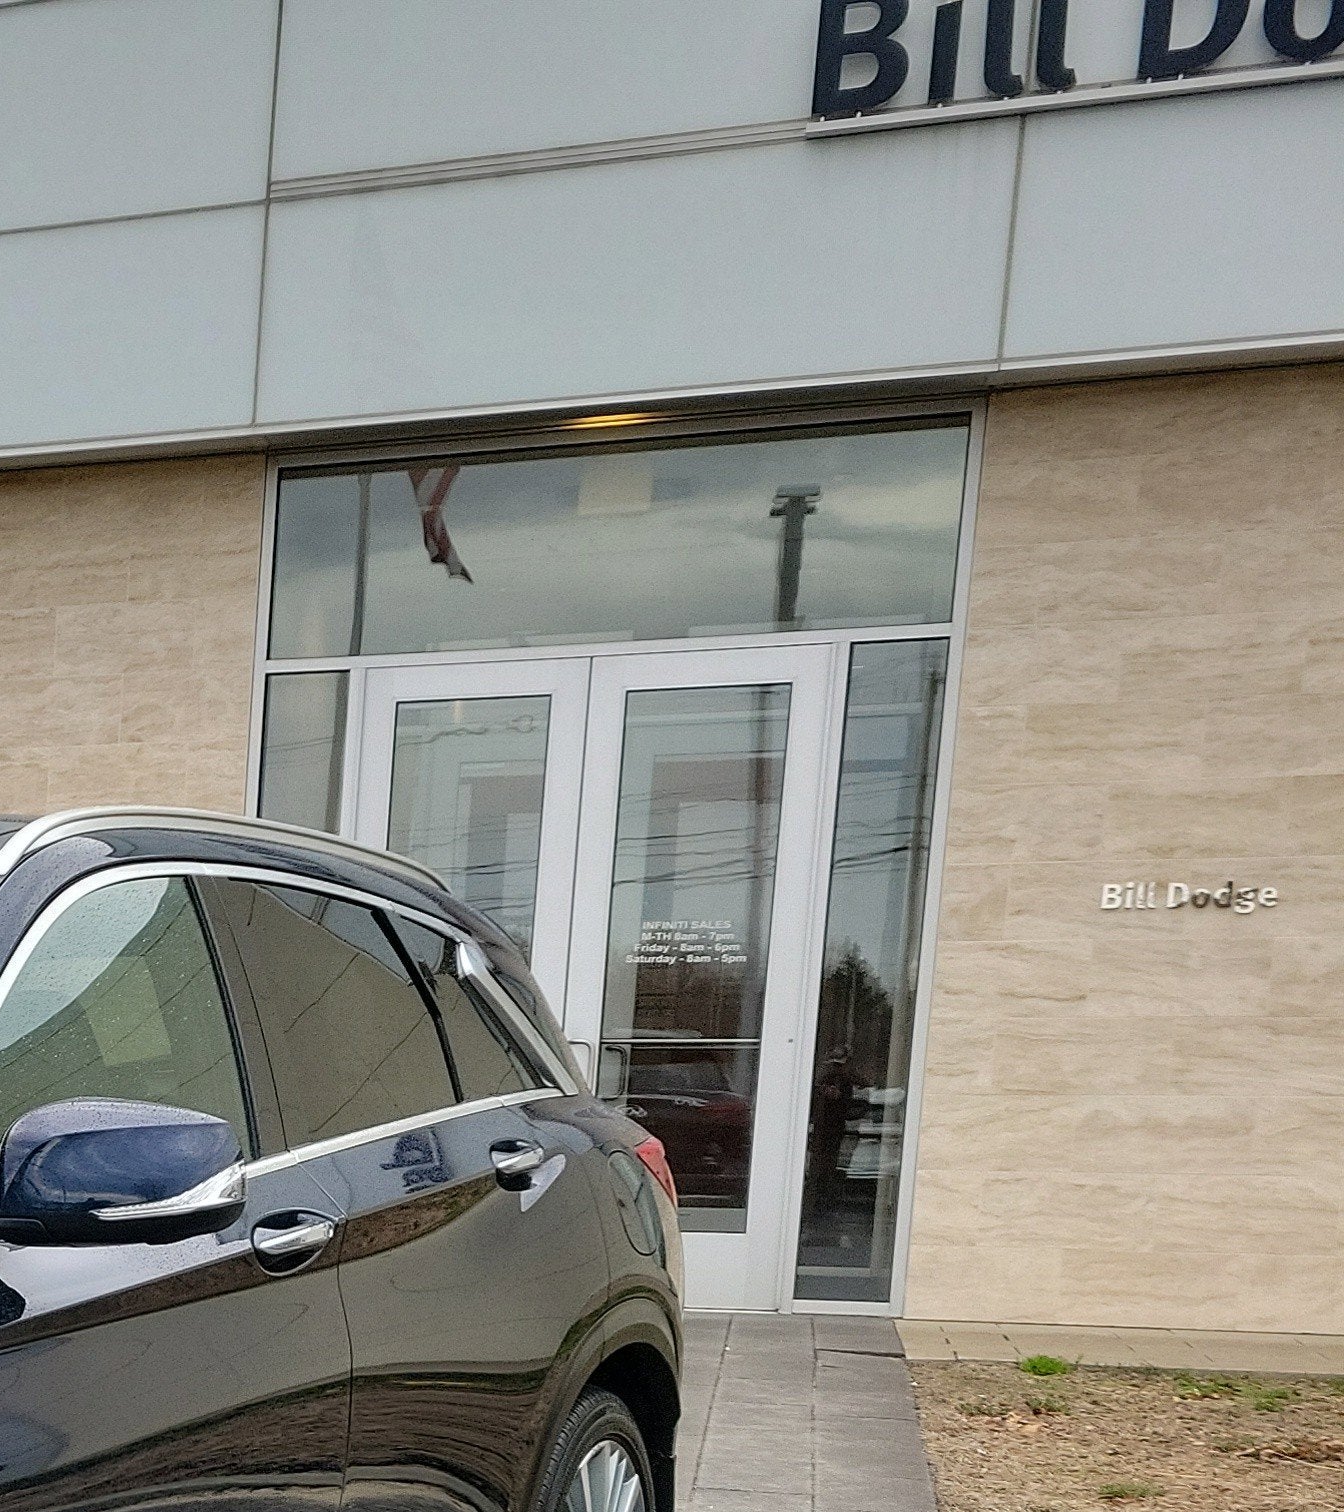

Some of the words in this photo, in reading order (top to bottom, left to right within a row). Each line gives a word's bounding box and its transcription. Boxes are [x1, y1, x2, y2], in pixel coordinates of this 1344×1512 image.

[1100, 881, 1156, 910] Bill
[1165, 880, 1279, 914] Dodge
[642, 920, 688, 929] INFINITI
[690, 920, 732, 929] SALES
[709, 931, 735, 942] 7pm
[634, 943, 671, 954] Friday
[626, 954, 677, 966] Saturday
